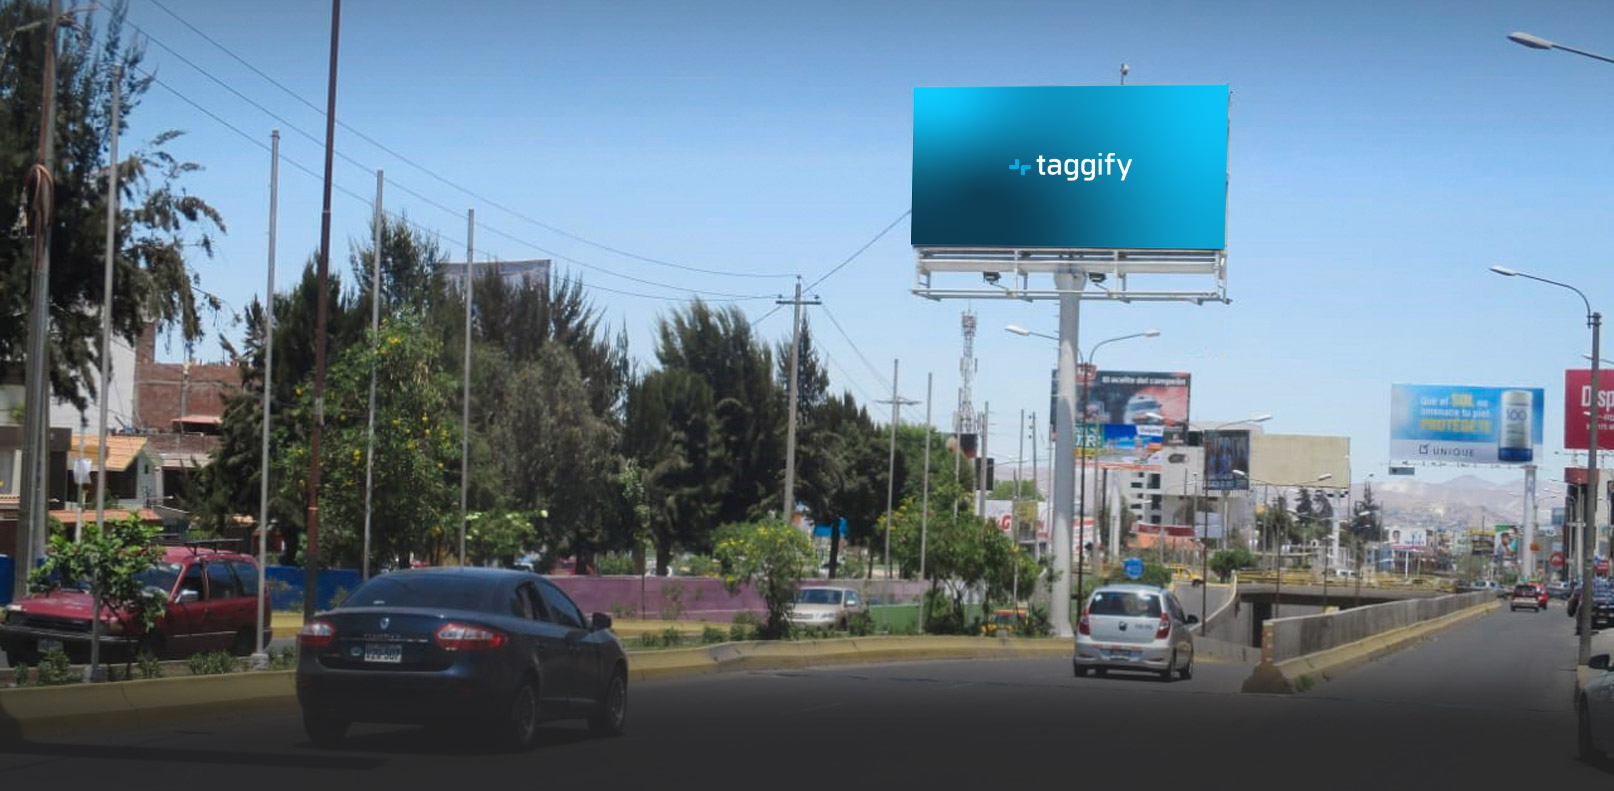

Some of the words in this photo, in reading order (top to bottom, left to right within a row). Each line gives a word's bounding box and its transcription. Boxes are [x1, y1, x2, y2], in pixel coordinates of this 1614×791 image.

[1036, 152, 1133, 182] taggify
[1102, 376, 1110, 384] El
[1111, 376, 1135, 384] aceite
[1136, 377, 1148, 385] del
[1421, 397, 1437, 406] Que
[1439, 397, 1449, 406] el
[1581, 385, 1614, 412] Dsp
[1461, 409, 1472, 417] tu
[1432, 445, 1474, 457] UNIQUE
